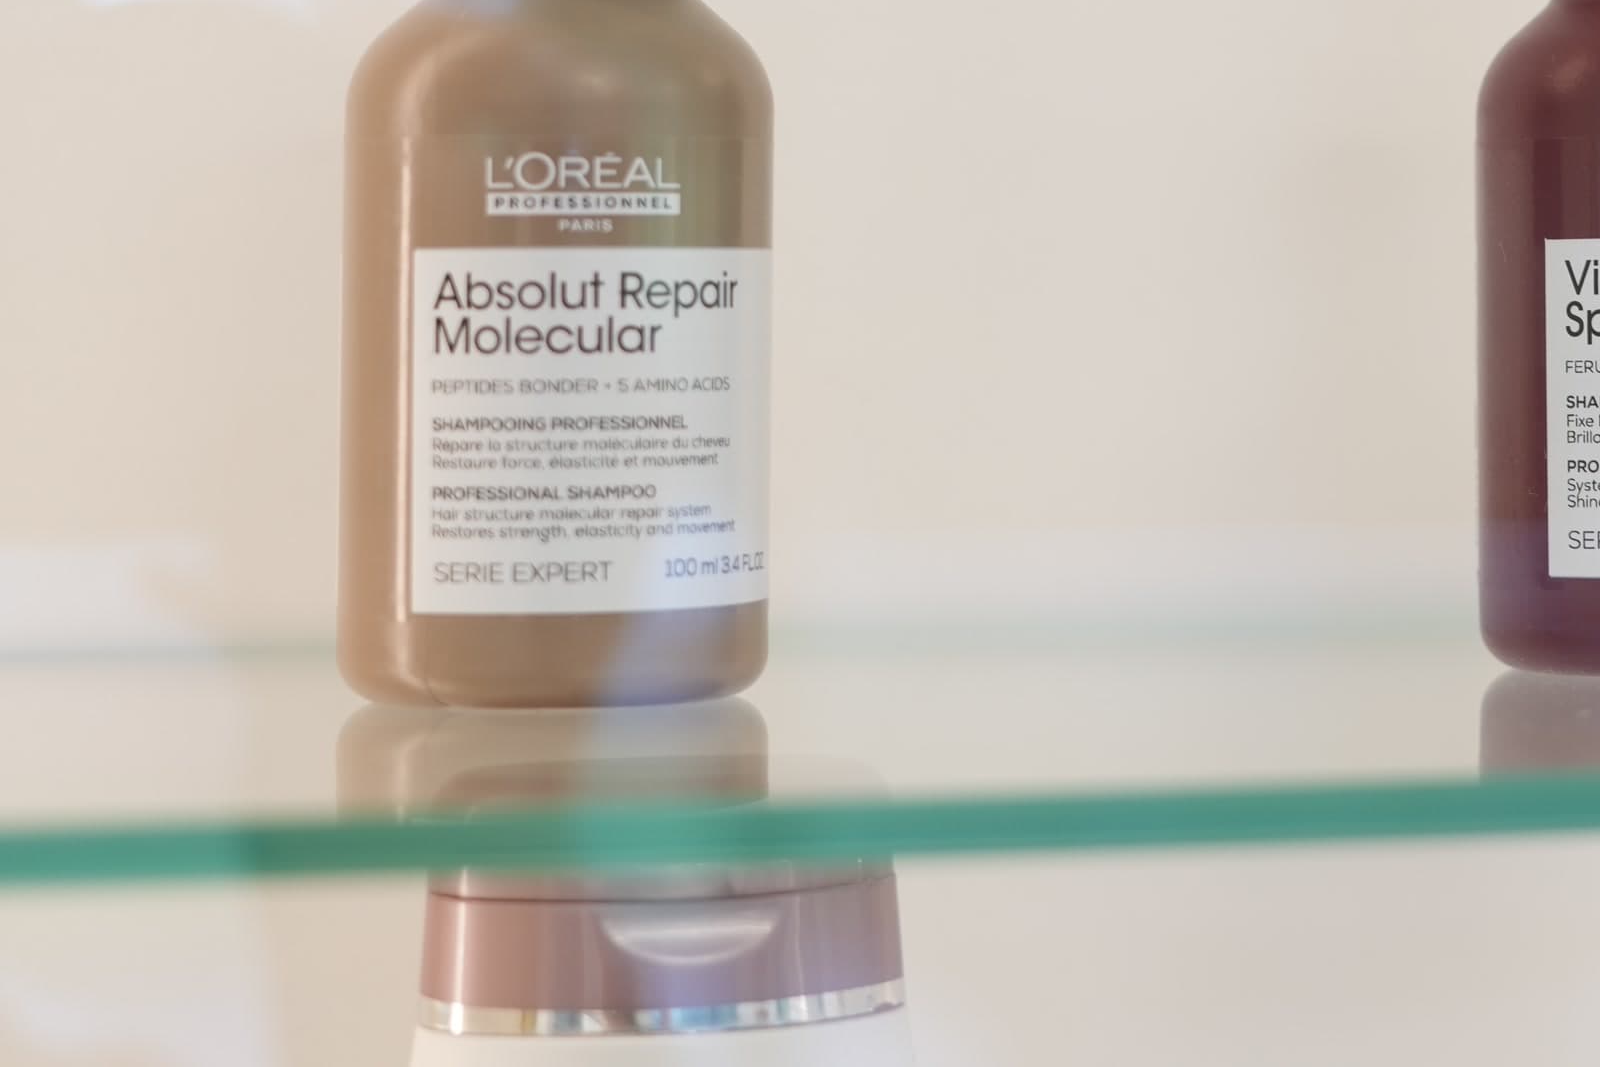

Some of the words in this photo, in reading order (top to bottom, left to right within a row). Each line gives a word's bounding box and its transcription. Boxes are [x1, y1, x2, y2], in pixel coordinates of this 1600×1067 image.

[485, 151, 681, 190] L'ORÉAL
[494, 197, 673, 210] PROFESSIONNEL
[559, 219, 613, 232] PARIS
[433, 271, 605, 310] Absolut
[620, 270, 738, 317] Repair
[433, 315, 662, 355] Molecular
[431, 379, 514, 395] PEPTIDES
[519, 378, 599, 394] BONDER
[617, 377, 629, 393] 5
[633, 377, 689, 392] AMINO
[692, 376, 730, 391] ACIDS
[432, 417, 547, 431] SHAMPOOING
[551, 415, 688, 431] PROFESSIONNEL
[1566, 414, 1594, 427] Fixe
[488, 437, 502, 451] la
[505, 438, 578, 451] structure
[583, 436, 668, 451] moléculaire
[672, 436, 689, 449] du
[692, 435, 731, 448] cheveu
[432, 455, 498, 469] Restaure
[549, 454, 620, 469] élasticité
[624, 454, 640, 467] et
[643, 453, 719, 467] mouvement
[432, 485, 563, 501] PROFESSIONAL
[567, 484, 657, 500] SHAMPOO
[432, 507, 459, 521] Hair
[464, 507, 534, 521] structure
[539, 506, 616, 520] molecular
[620, 505, 664, 522] repair
[667, 503, 712, 518] system
[432, 523, 497, 538] Restores
[575, 522, 641, 540] elasticity
[646, 522, 673, 535] and
[677, 519, 736, 533] movement
[434, 561, 505, 583] SERIE
[512, 559, 613, 582] EXPERT
[664, 557, 698, 578] 100
[701, 556, 719, 575] ml
